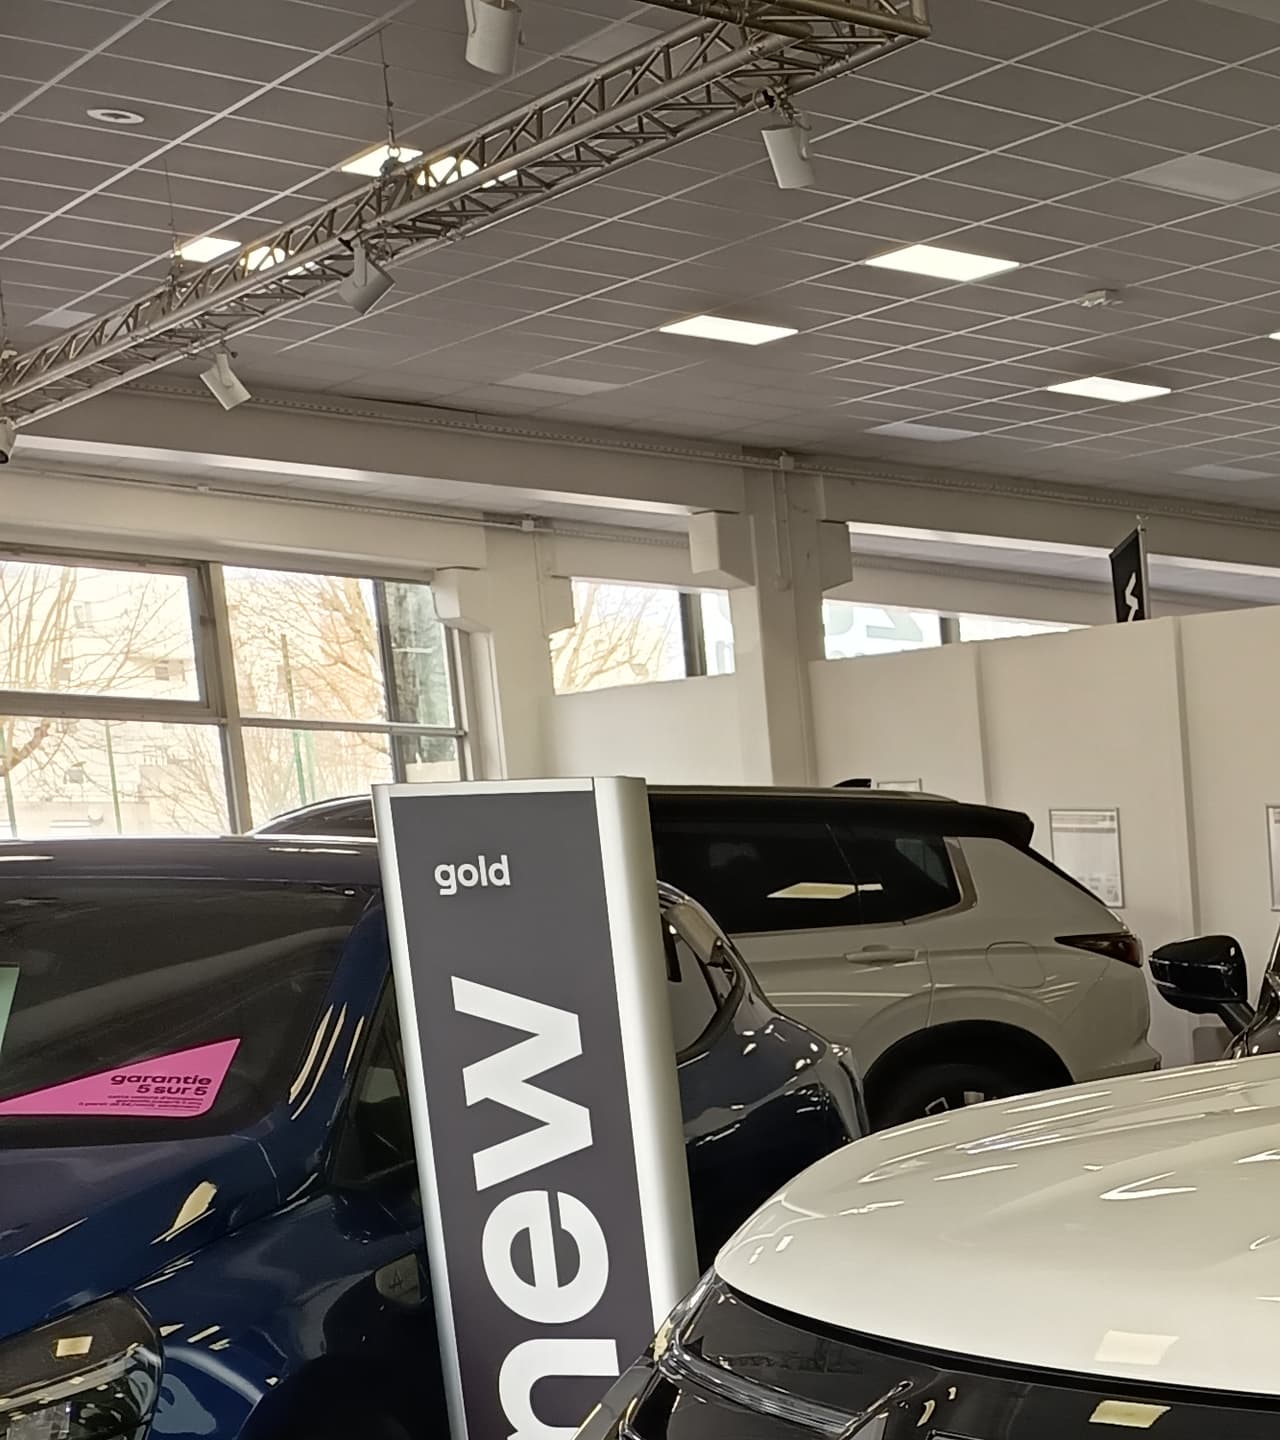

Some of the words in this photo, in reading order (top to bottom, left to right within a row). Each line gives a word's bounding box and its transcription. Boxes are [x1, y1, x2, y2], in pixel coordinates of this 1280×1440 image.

[434, 855, 511, 895] gold
[111, 1074, 212, 1086] garantie
[136, 1084, 150, 1094] 5
[153, 1085, 192, 1096] sur
[194, 1085, 208, 1096] 5
